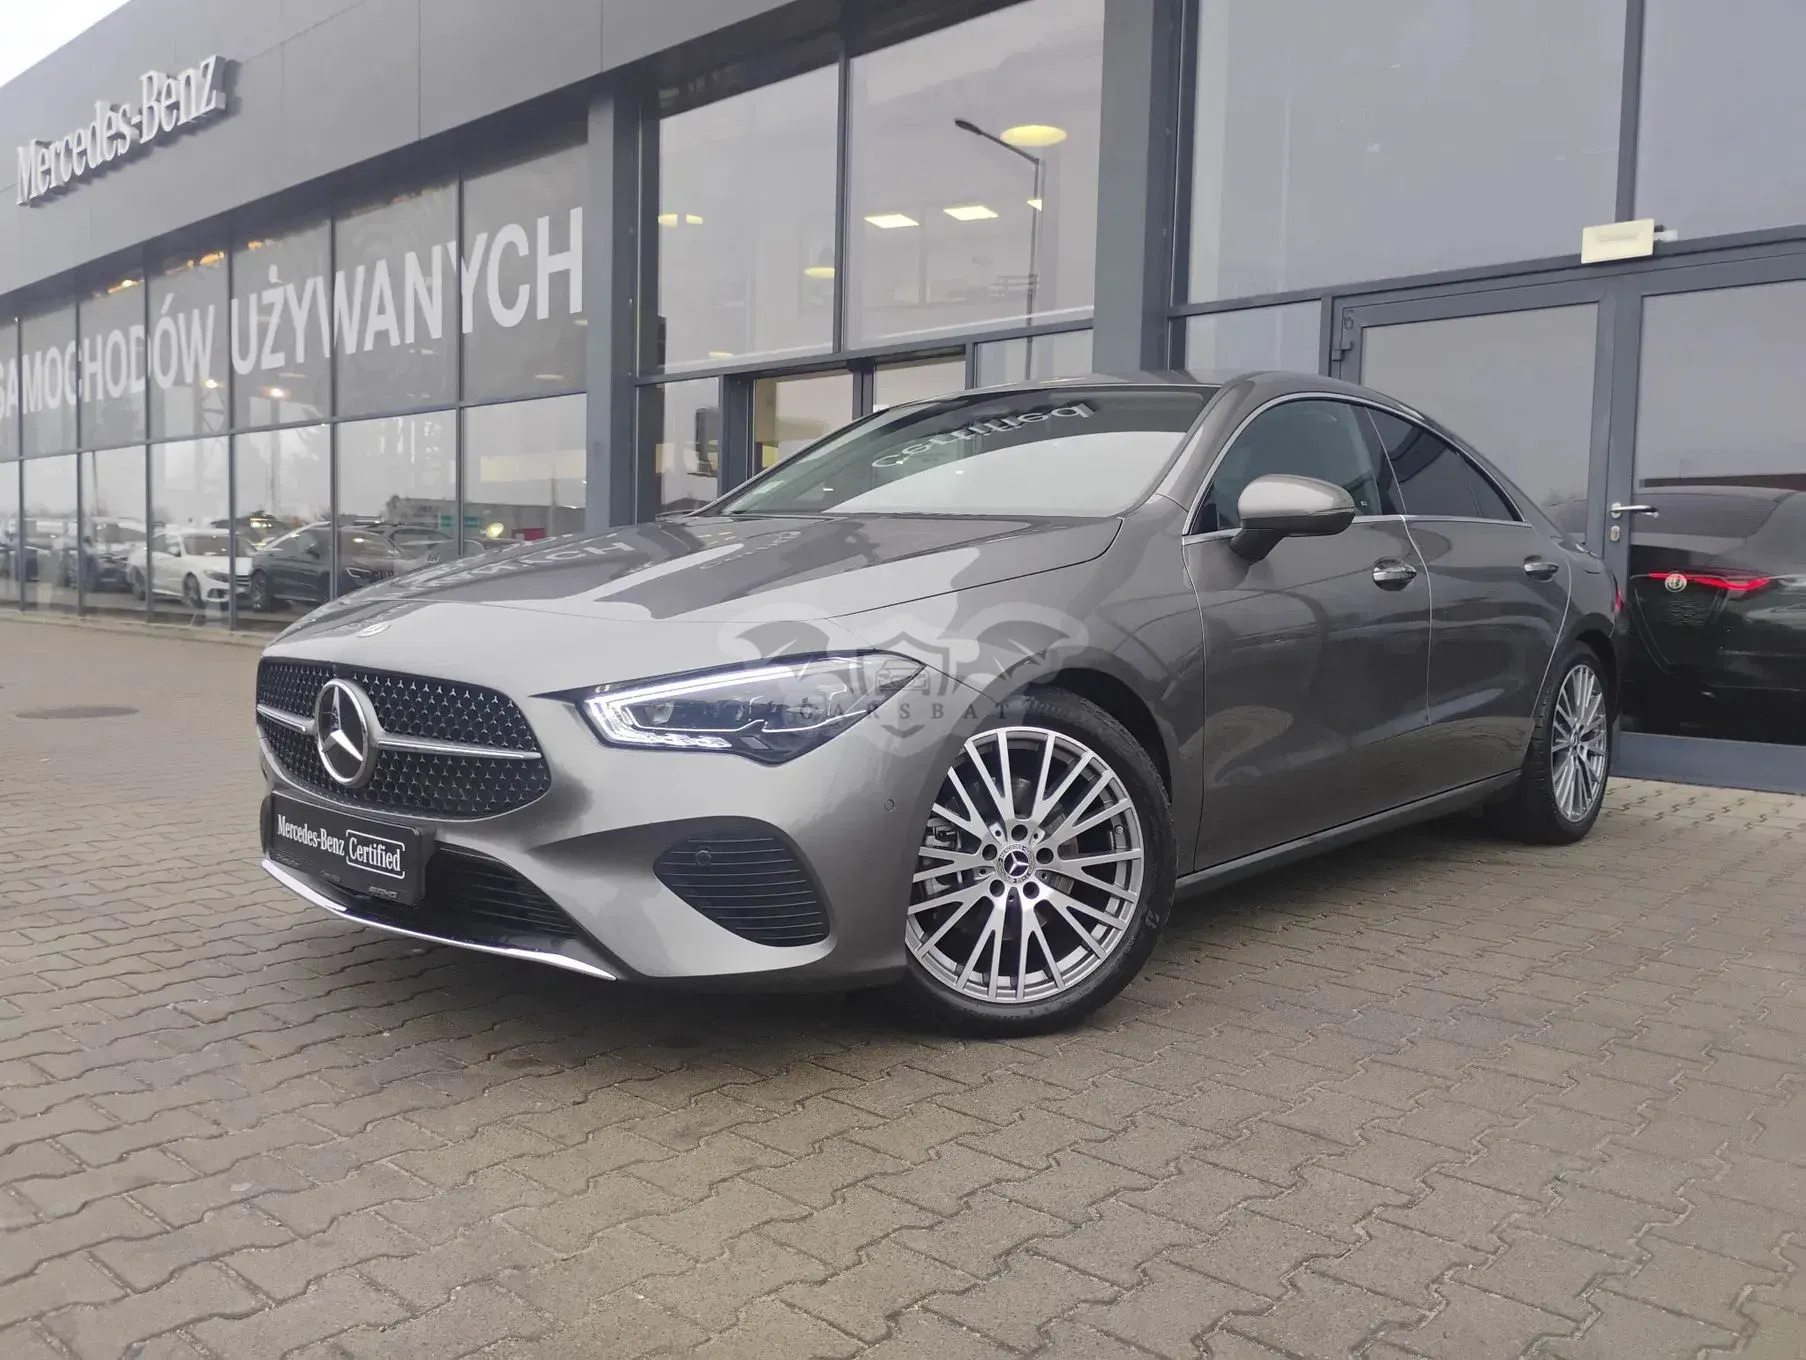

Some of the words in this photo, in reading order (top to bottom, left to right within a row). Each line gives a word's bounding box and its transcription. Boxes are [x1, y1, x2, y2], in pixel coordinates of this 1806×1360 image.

[16, 55, 225, 206] Mercedes-Benz
[0, 292, 215, 419] AMOCHODÓW
[231, 207, 583, 375] UŻYWANYCH
[277, 814, 345, 857] Mercedes-Benz
[350, 837, 401, 872] Certified
